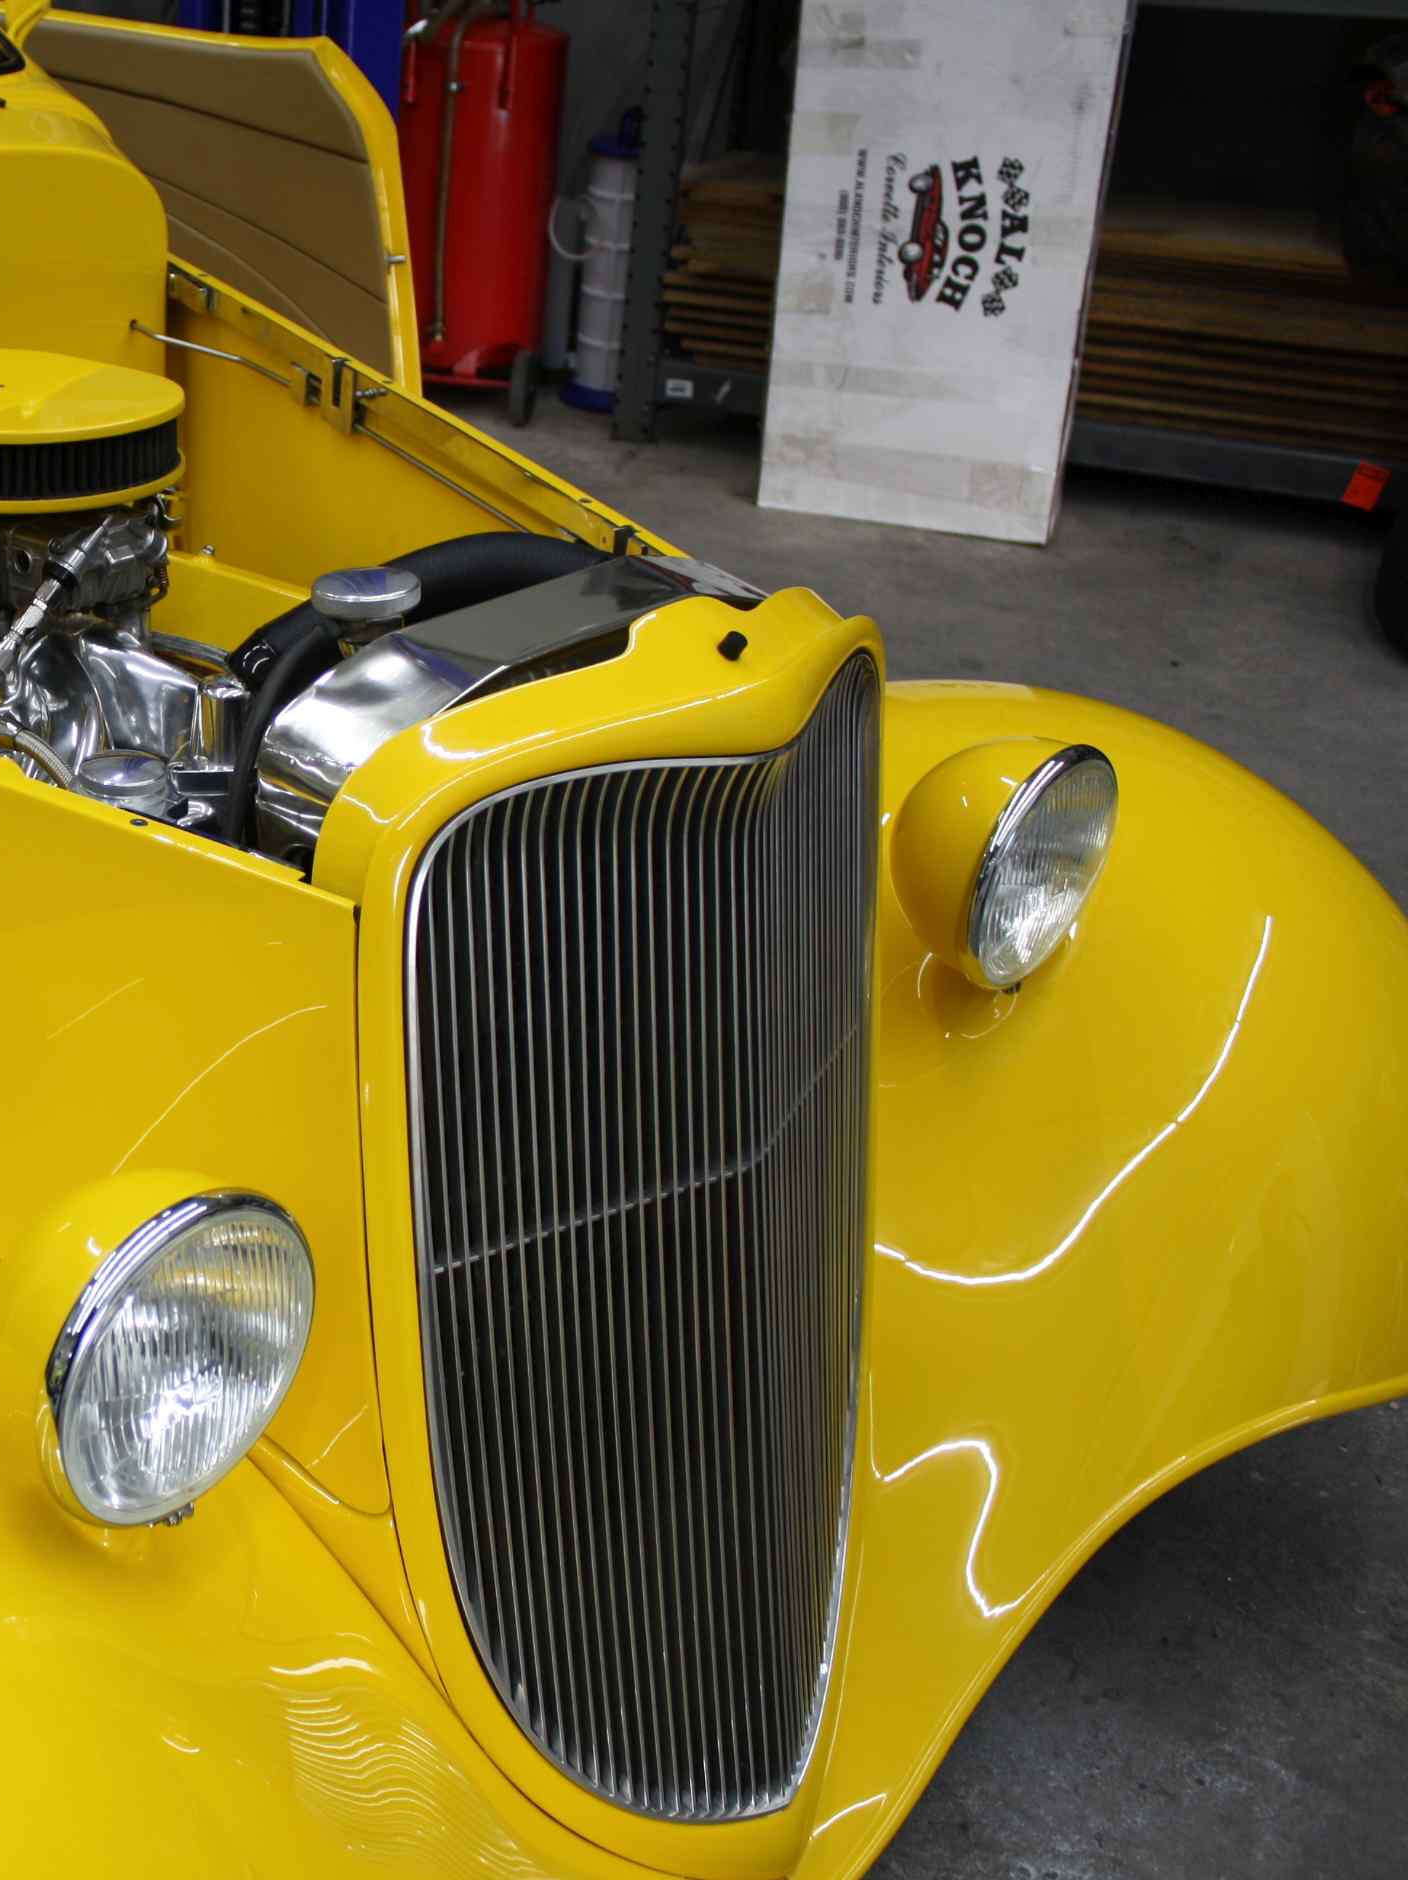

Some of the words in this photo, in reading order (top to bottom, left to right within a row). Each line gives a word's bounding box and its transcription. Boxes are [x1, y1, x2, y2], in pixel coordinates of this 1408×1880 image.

[879, 153, 908, 223] Corvette
[872, 226, 900, 305] Interiors
[935, 156, 989, 312] KNOCH
[994, 209, 1029, 266] AL
